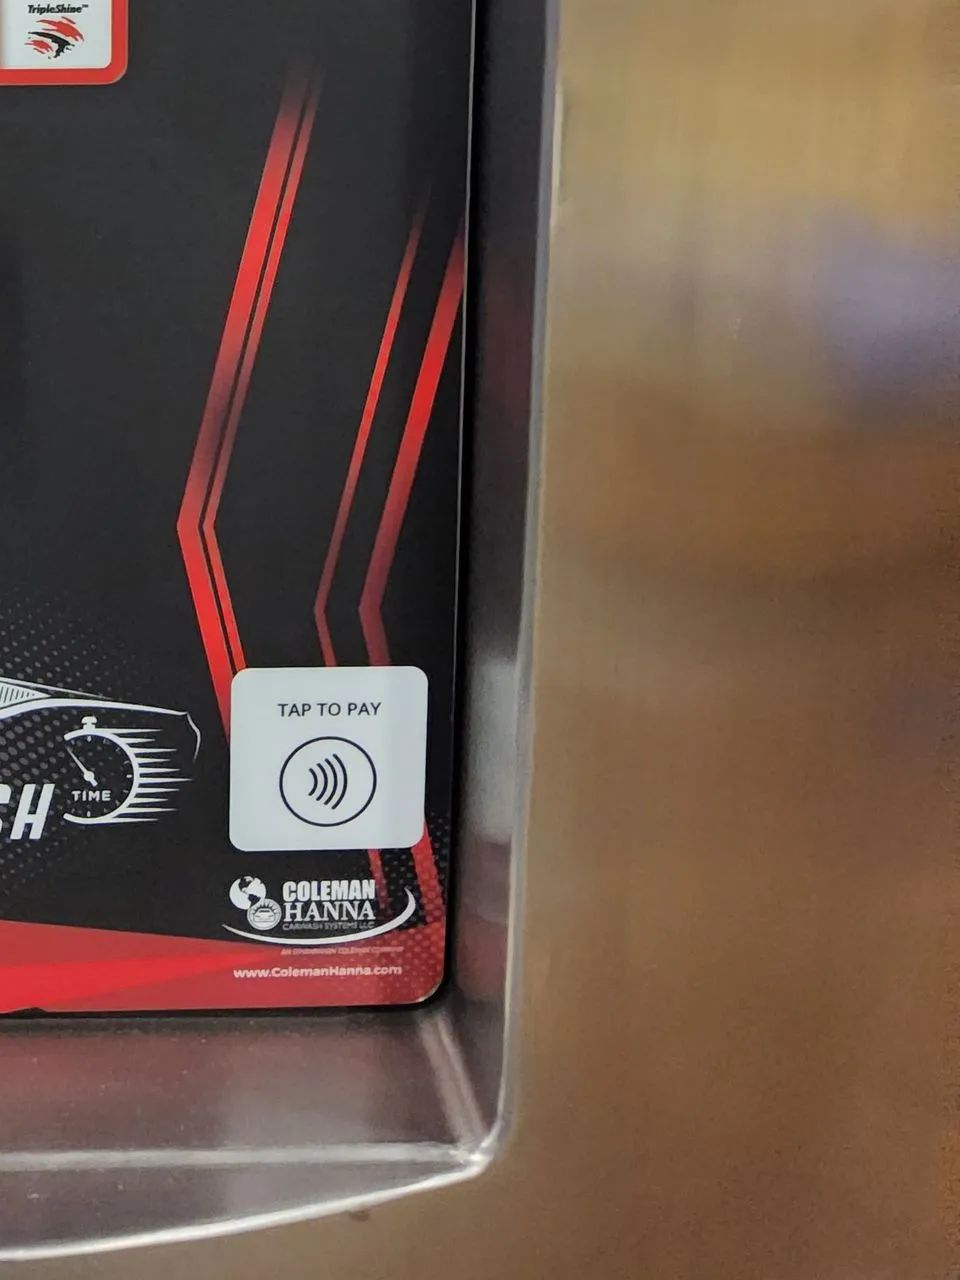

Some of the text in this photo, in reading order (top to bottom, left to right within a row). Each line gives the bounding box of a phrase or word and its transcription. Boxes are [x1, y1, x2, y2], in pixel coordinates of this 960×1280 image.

[278, 702, 382, 717] TAP TO PAY
[71, 790, 111, 802] TIME
[282, 879, 376, 901] COLEMAN
[283, 900, 376, 922] HANNA
[233, 966, 402, 979] www.ColemanHanna.com
